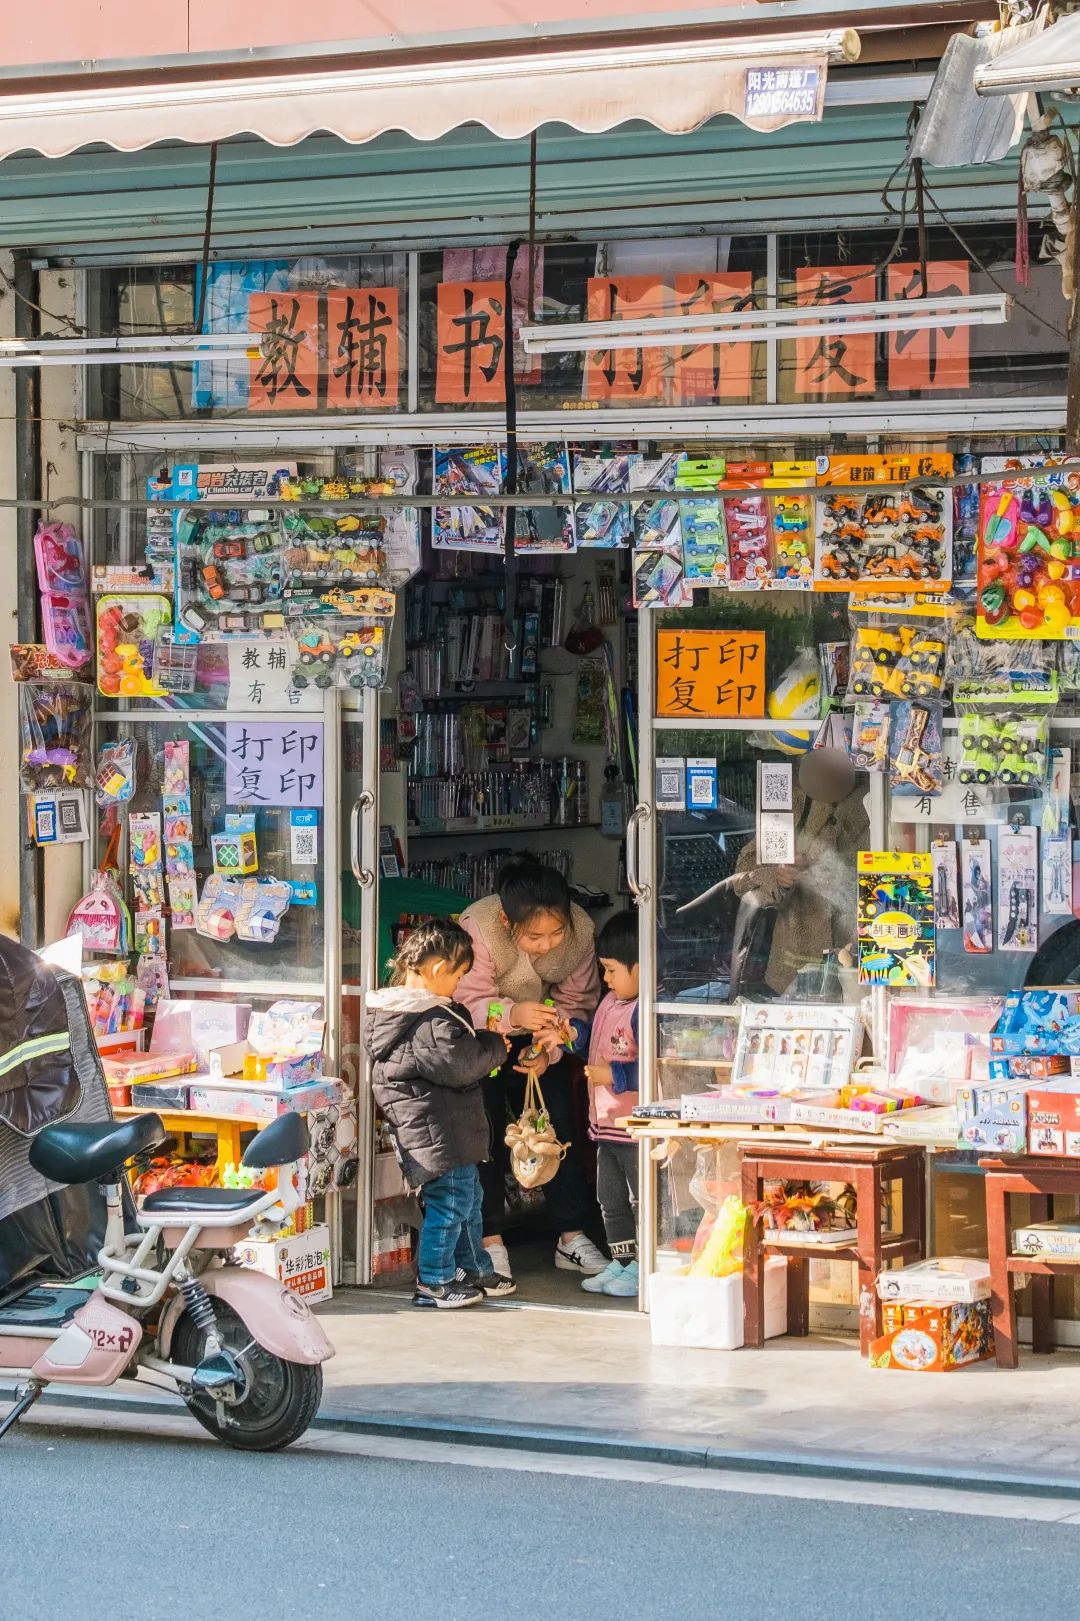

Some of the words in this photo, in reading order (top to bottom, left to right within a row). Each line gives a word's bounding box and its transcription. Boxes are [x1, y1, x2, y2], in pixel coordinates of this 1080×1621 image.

[241, 648, 287, 670] 教辅
[663, 636, 760, 675] 打印
[664, 676, 758, 714] 复印
[231, 728, 319, 764] 打印
[233, 766, 317, 803] 复印
[914, 790, 984, 816] 有售
[285, 1250, 323, 1275] 华彩泡泡
